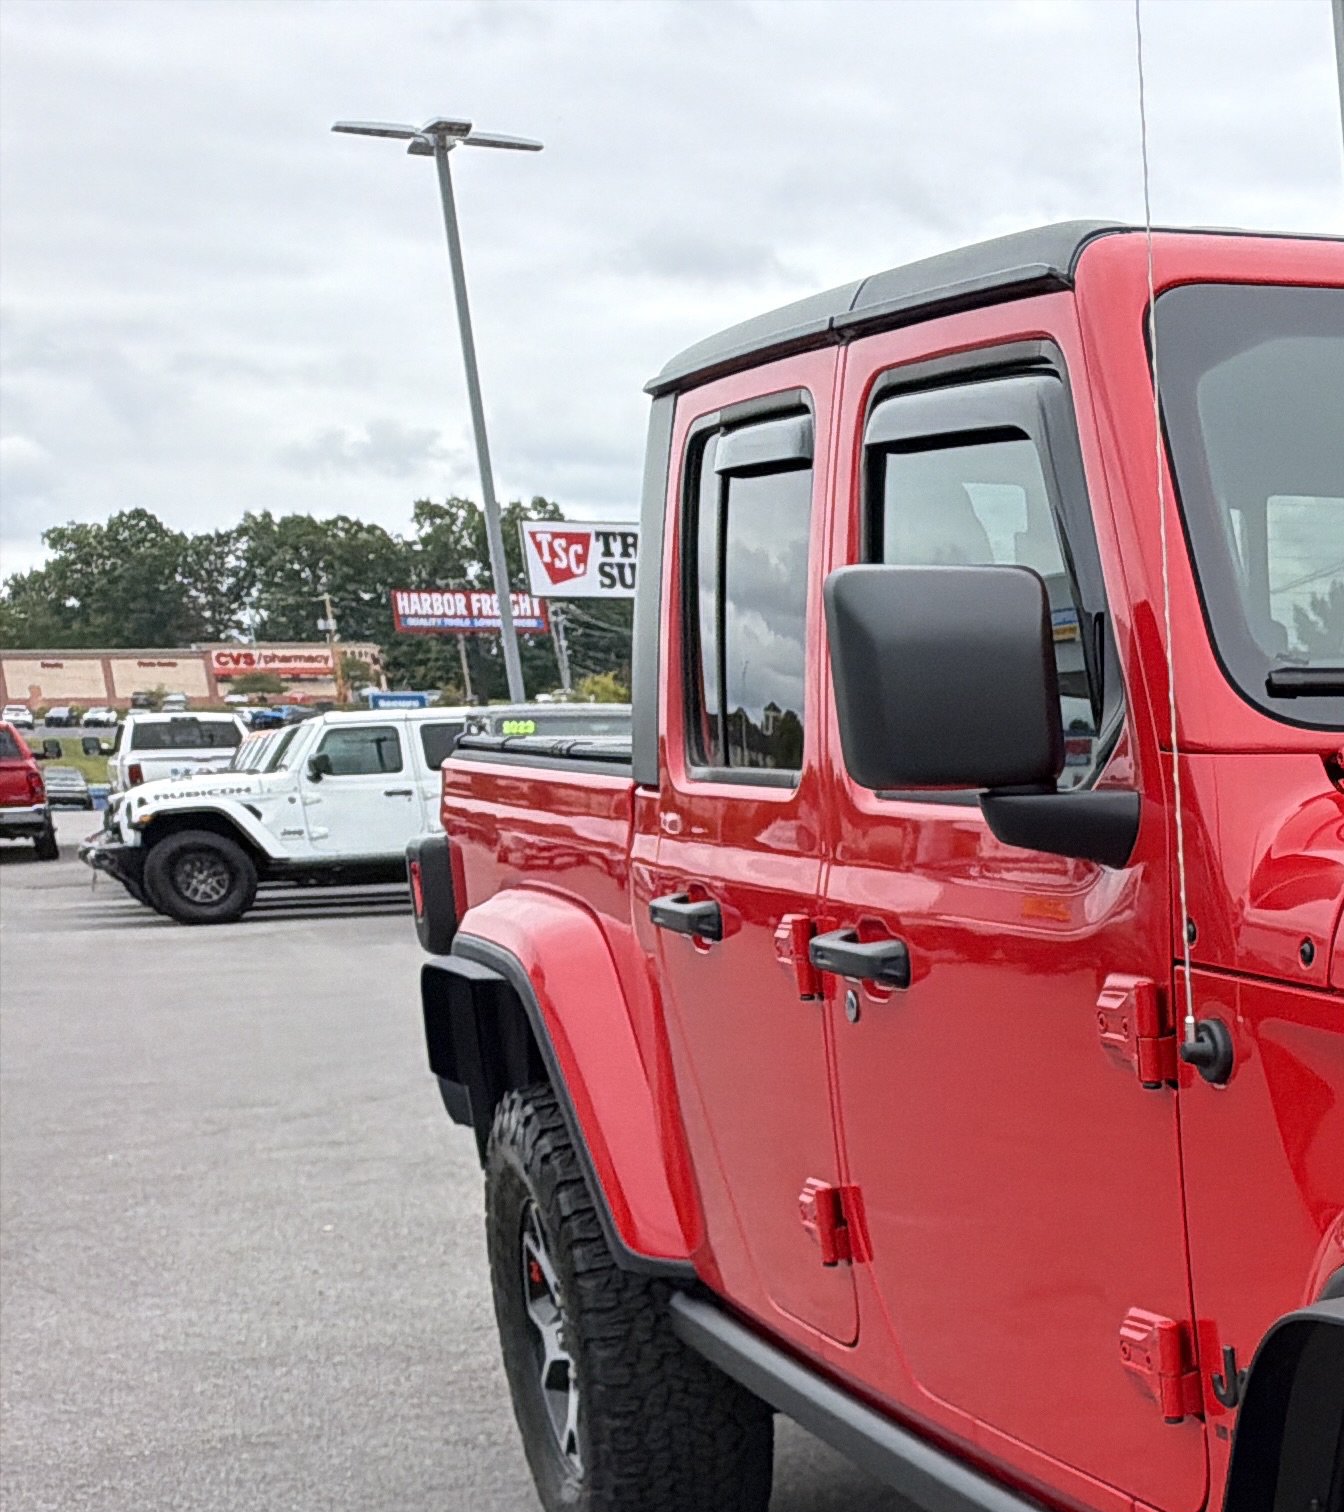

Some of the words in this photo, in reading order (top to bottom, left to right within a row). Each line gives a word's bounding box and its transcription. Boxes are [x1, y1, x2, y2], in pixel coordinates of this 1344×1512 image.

[535, 532, 585, 575] TSC
[396, 592, 468, 616] HARBOR
[470, 592, 541, 616] FREGHT
[154, 786, 251, 801] RUBICON
